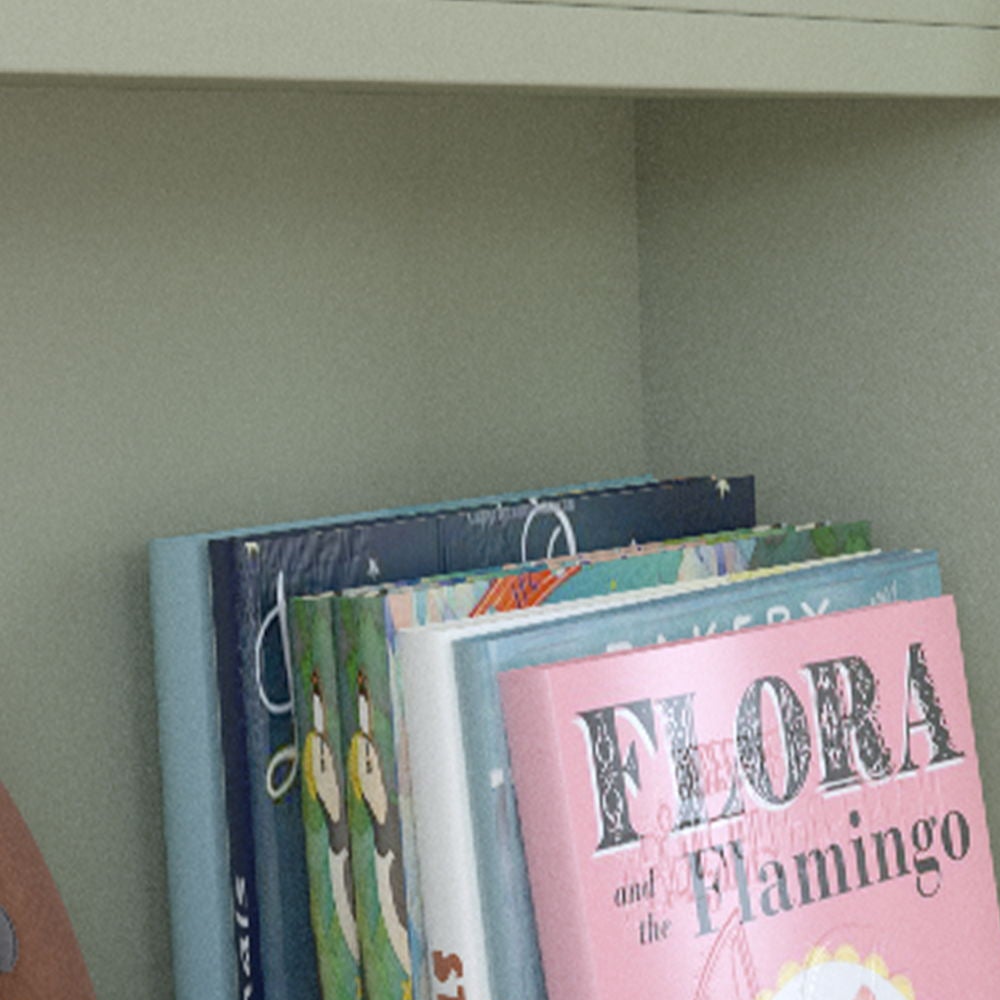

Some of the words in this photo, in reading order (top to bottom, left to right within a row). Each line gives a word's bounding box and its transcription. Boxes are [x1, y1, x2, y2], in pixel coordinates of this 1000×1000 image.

[572, 642, 966, 858] FLORA
[613, 868, 656, 908] and
[688, 808, 972, 938] Flamingo
[638, 912, 673, 946] the
